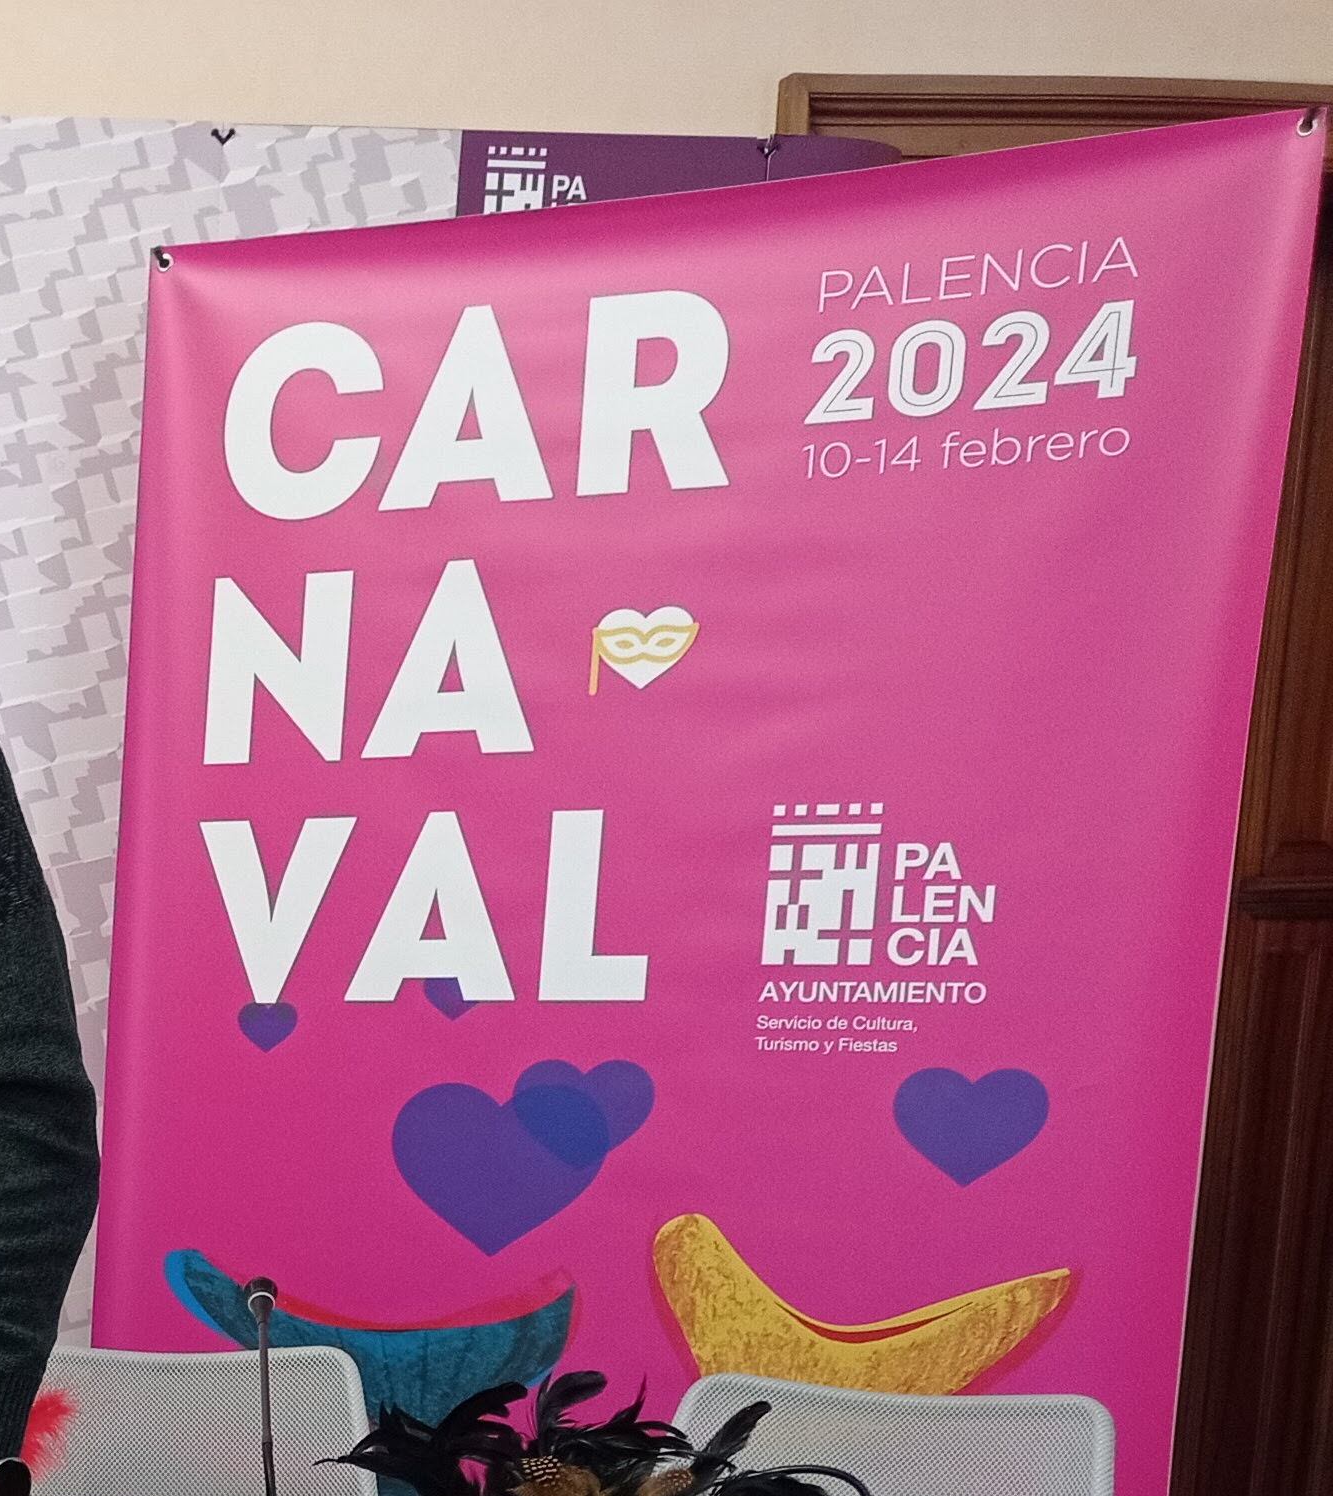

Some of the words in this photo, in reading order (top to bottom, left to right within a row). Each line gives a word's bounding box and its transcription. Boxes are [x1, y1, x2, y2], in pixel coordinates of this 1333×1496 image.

[552, 174, 587, 201] PA
[817, 237, 1139, 313] PALENCIA
[803, 300, 1137, 426] 2024
[223, 289, 730, 521] CAR
[802, 434, 923, 480] 10-14
[940, 422, 1131, 471] febrero
[202, 558, 535, 766] NA
[894, 842, 963, 880] PA
[199, 808, 650, 1004] VAL
[890, 885, 996, 923] LEN
[886, 927, 979, 966] CIA
[758, 981, 988, 1004] AYUNTAMIENTO
[755, 1015, 822, 1030] Servicio
[826, 1016, 848, 1030] de
[852, 1015, 918, 1032] Cultura,
[754, 1036, 820, 1052] Turismo
[823, 1040, 834, 1055] y
[838, 1037, 899, 1052] Fiestas
